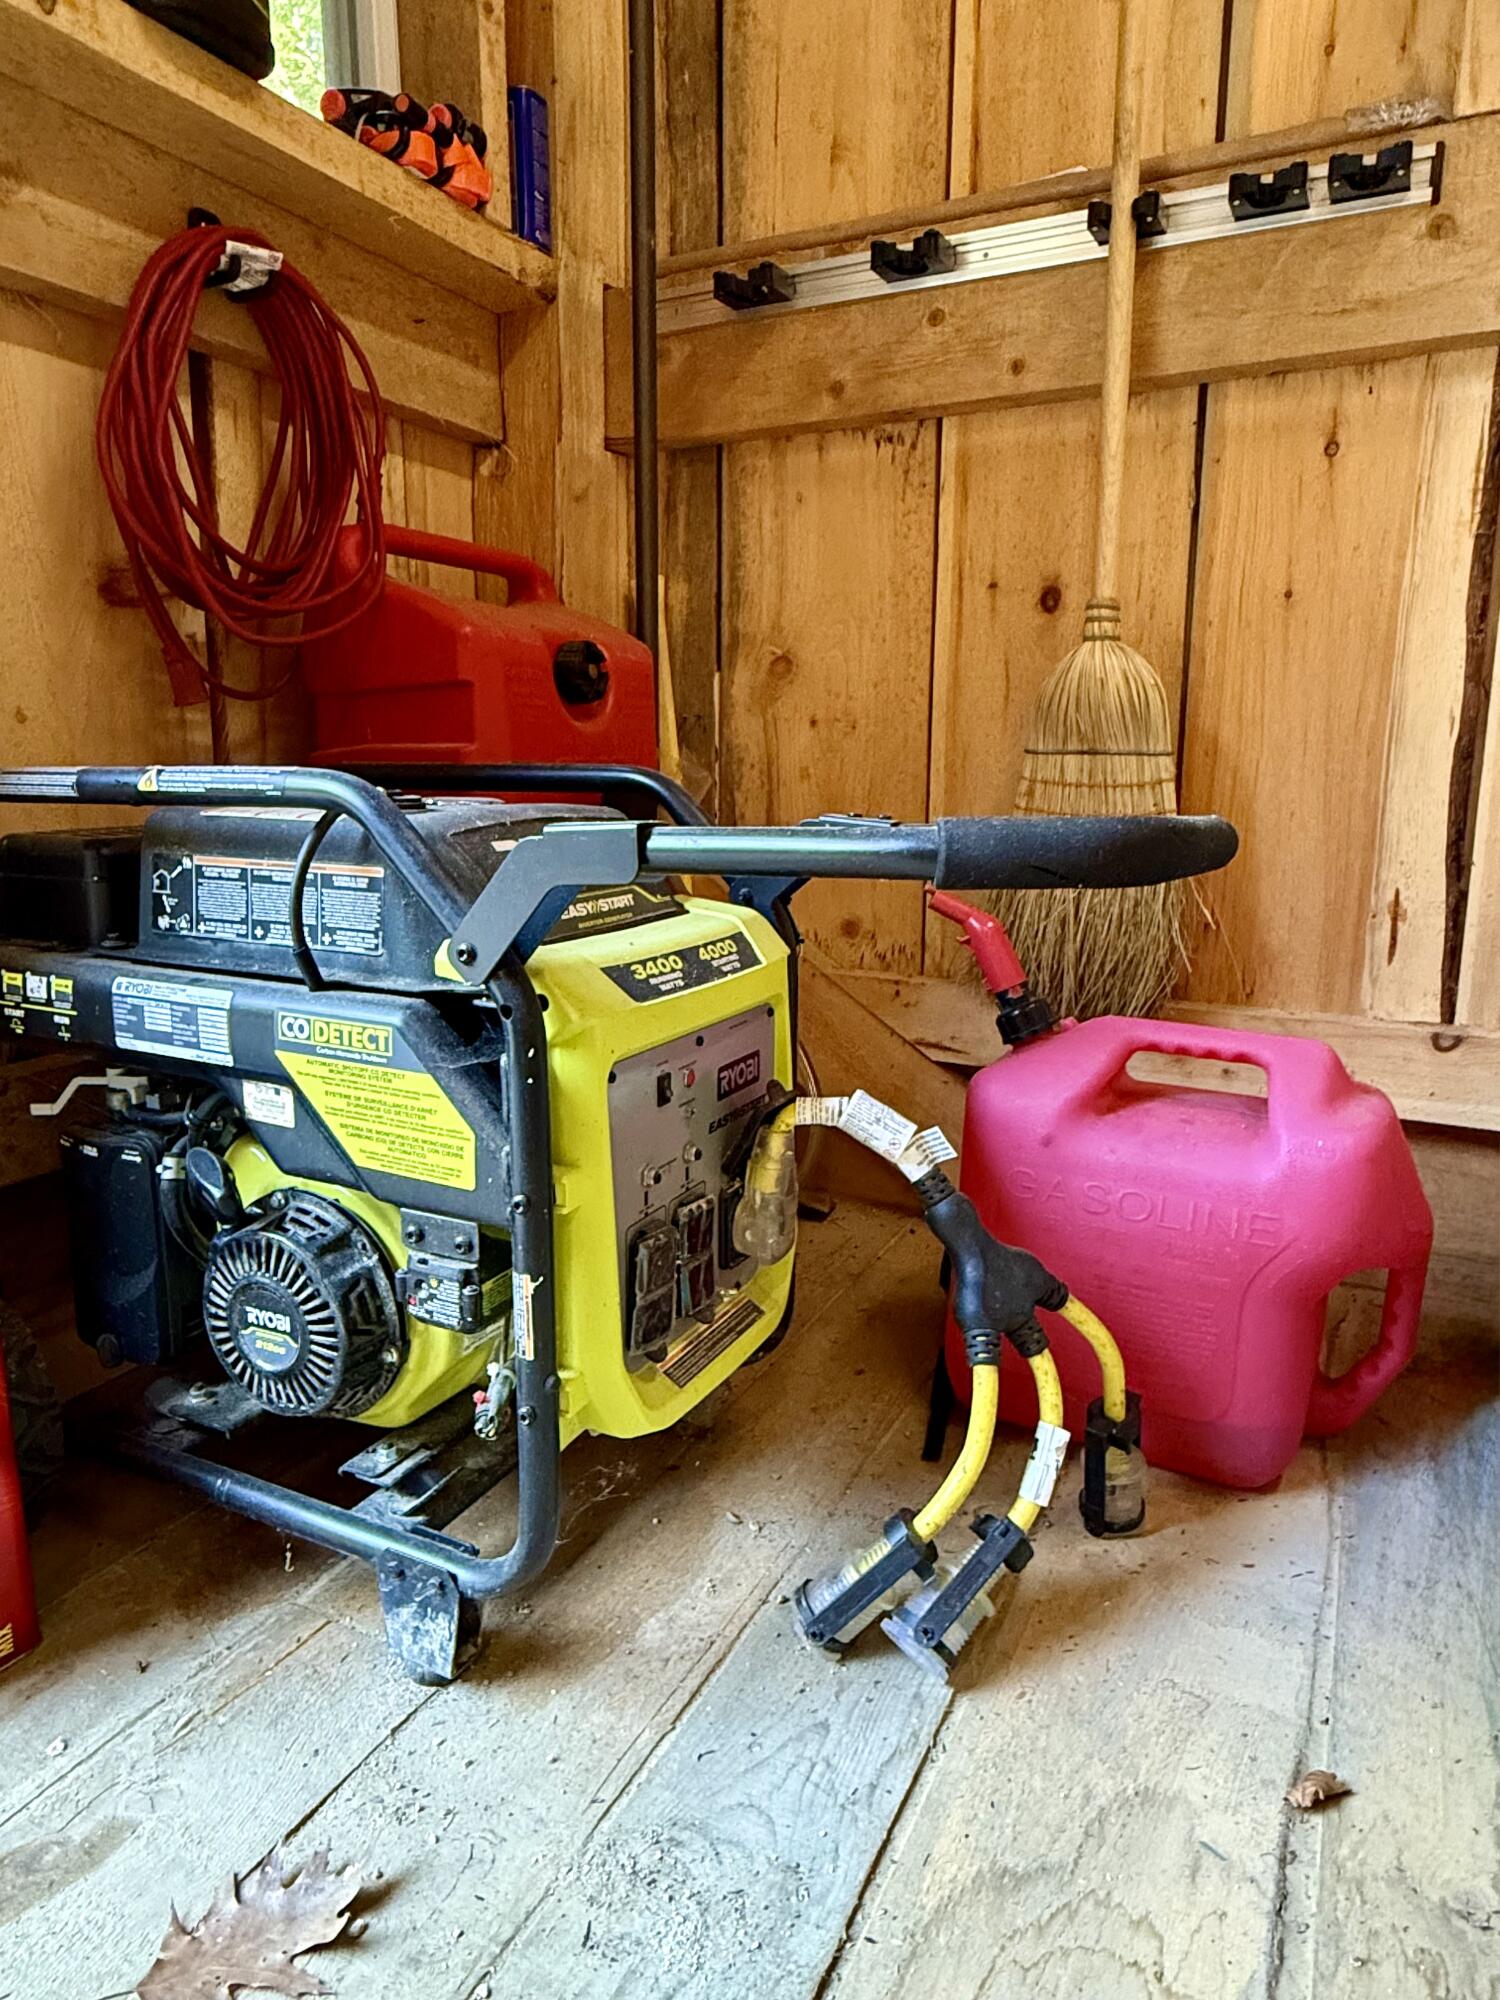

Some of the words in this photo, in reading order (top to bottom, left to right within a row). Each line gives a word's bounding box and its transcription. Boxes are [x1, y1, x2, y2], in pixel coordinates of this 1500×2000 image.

[698, 939, 738, 961] 4000
[630, 954, 684, 980] 3400
[124, 981, 153, 995] RYOBI
[658, 979, 685, 992] WATTS
[281, 1016, 310, 1039] CO
[313, 1020, 389, 1052] DETECT
[306, 1059, 340, 1070] AUTOMATIC
[342, 1064, 368, 1074] SHUTOFF
[381, 1071, 405, 1080] DETECT
[328, 1068, 366, 1079] MONITORING
[368, 1074, 392, 1084] SYSTEM
[720, 1055, 758, 1095] RYOBI
[1007, 1167, 1282, 1249] GASOLINE
[245, 1305, 291, 1333] RYOBI
